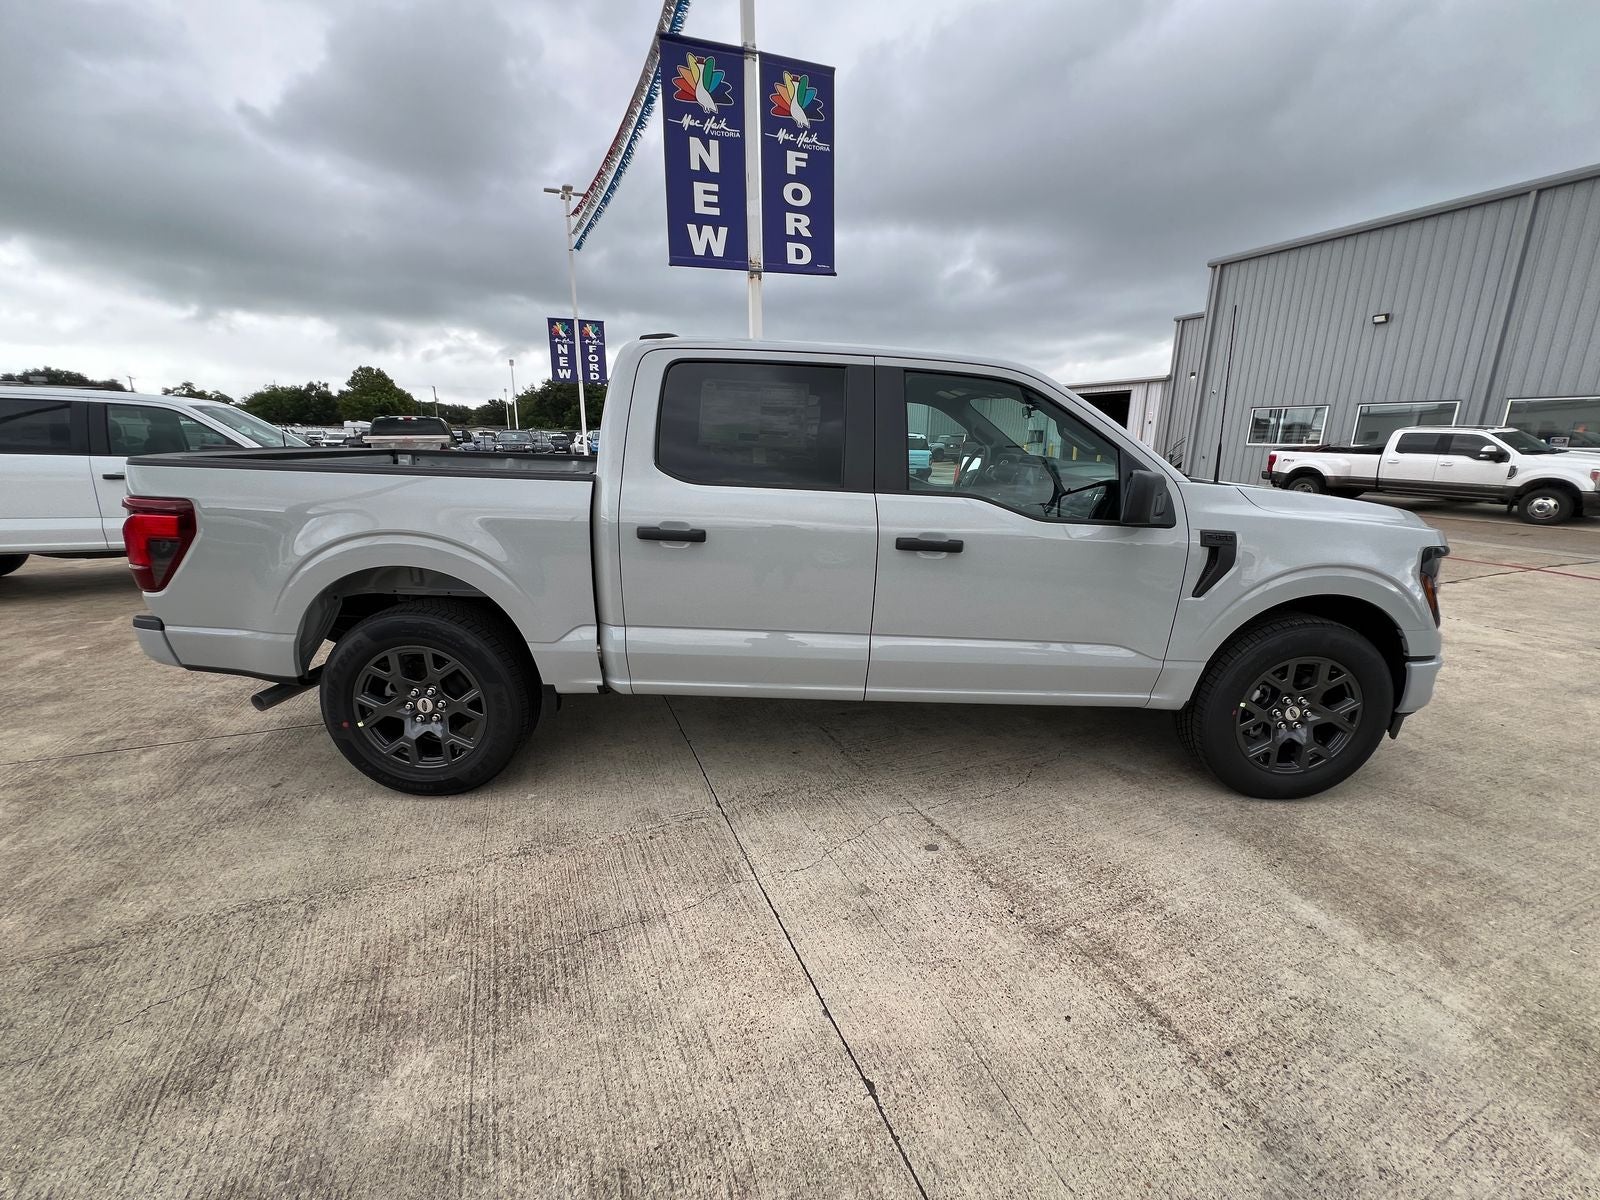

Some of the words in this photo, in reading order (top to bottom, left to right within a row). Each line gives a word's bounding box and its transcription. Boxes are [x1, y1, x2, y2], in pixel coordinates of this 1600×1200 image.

[668, 113, 703, 131] Mac
[704, 114, 740, 134] Haik
[710, 130, 741, 138] VICTORIA
[765, 128, 799, 144] Mac
[798, 132, 830, 148] Haik
[802, 143, 831, 152] VICTORIA
[686, 136, 728, 257] NEW
[782, 150, 812, 265] FORD
[557, 344, 571, 379] NEW
[588, 345, 600, 380] FORD
